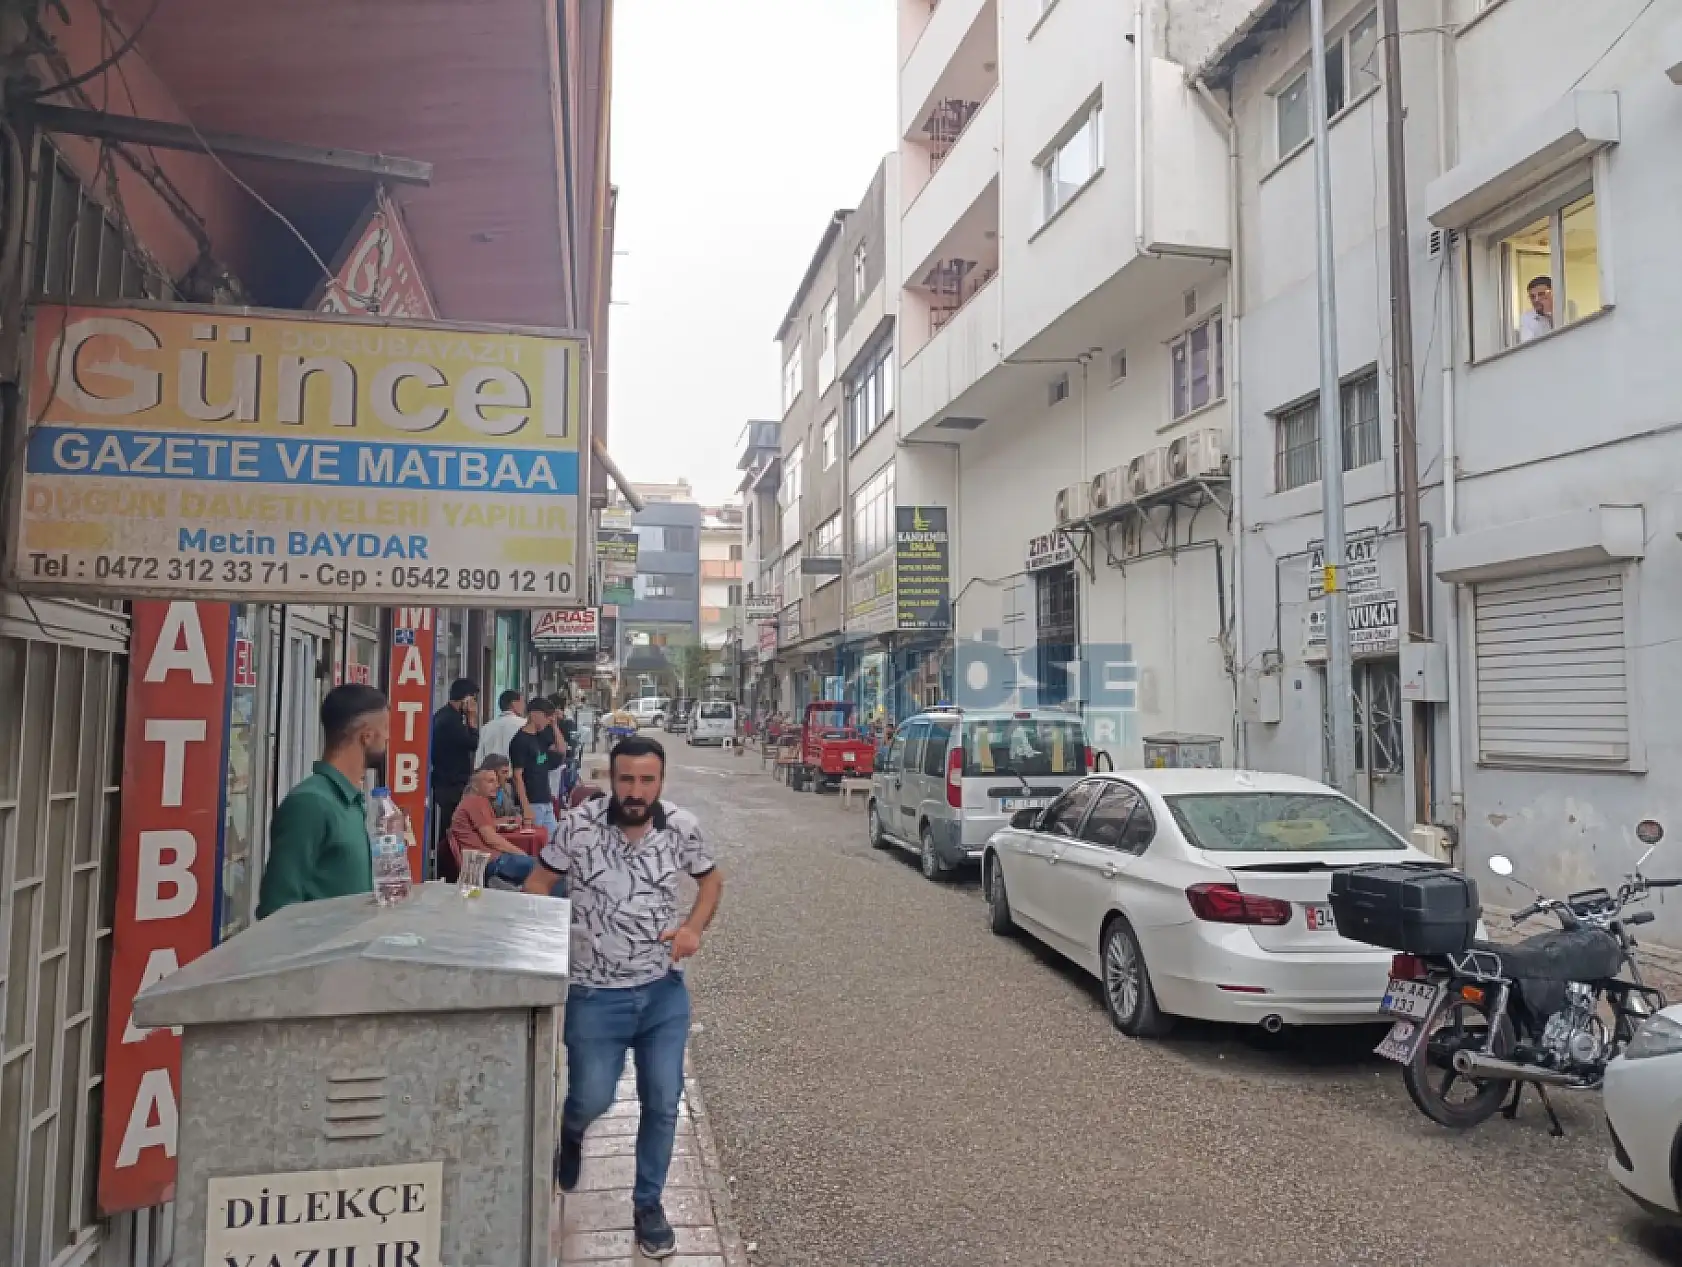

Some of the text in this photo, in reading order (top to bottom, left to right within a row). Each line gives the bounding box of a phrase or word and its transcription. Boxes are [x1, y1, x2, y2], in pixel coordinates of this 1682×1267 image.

[47, 317, 569, 438] Güncel
[53, 432, 558, 490] GAZETE VE MATBAA
[178, 527, 429, 561] Metin BAYDAR
[1312, 540, 1375, 568] AKAT
[29, 553, 68, 578] Tel
[95, 555, 159, 580] 0472
[168, 557, 214, 582] 312
[222, 559, 253, 584] 33
[261, 561, 289, 585] 71
[316, 562, 368, 592] Cep
[391, 566, 450, 590] 0542
[457, 568, 501, 591] 890
[508, 570, 537, 593] 12
[543, 571, 571, 594] 10
[115, 601, 215, 1169] ATBAA
[225, 1183, 425, 1230] DİLEKÇE
